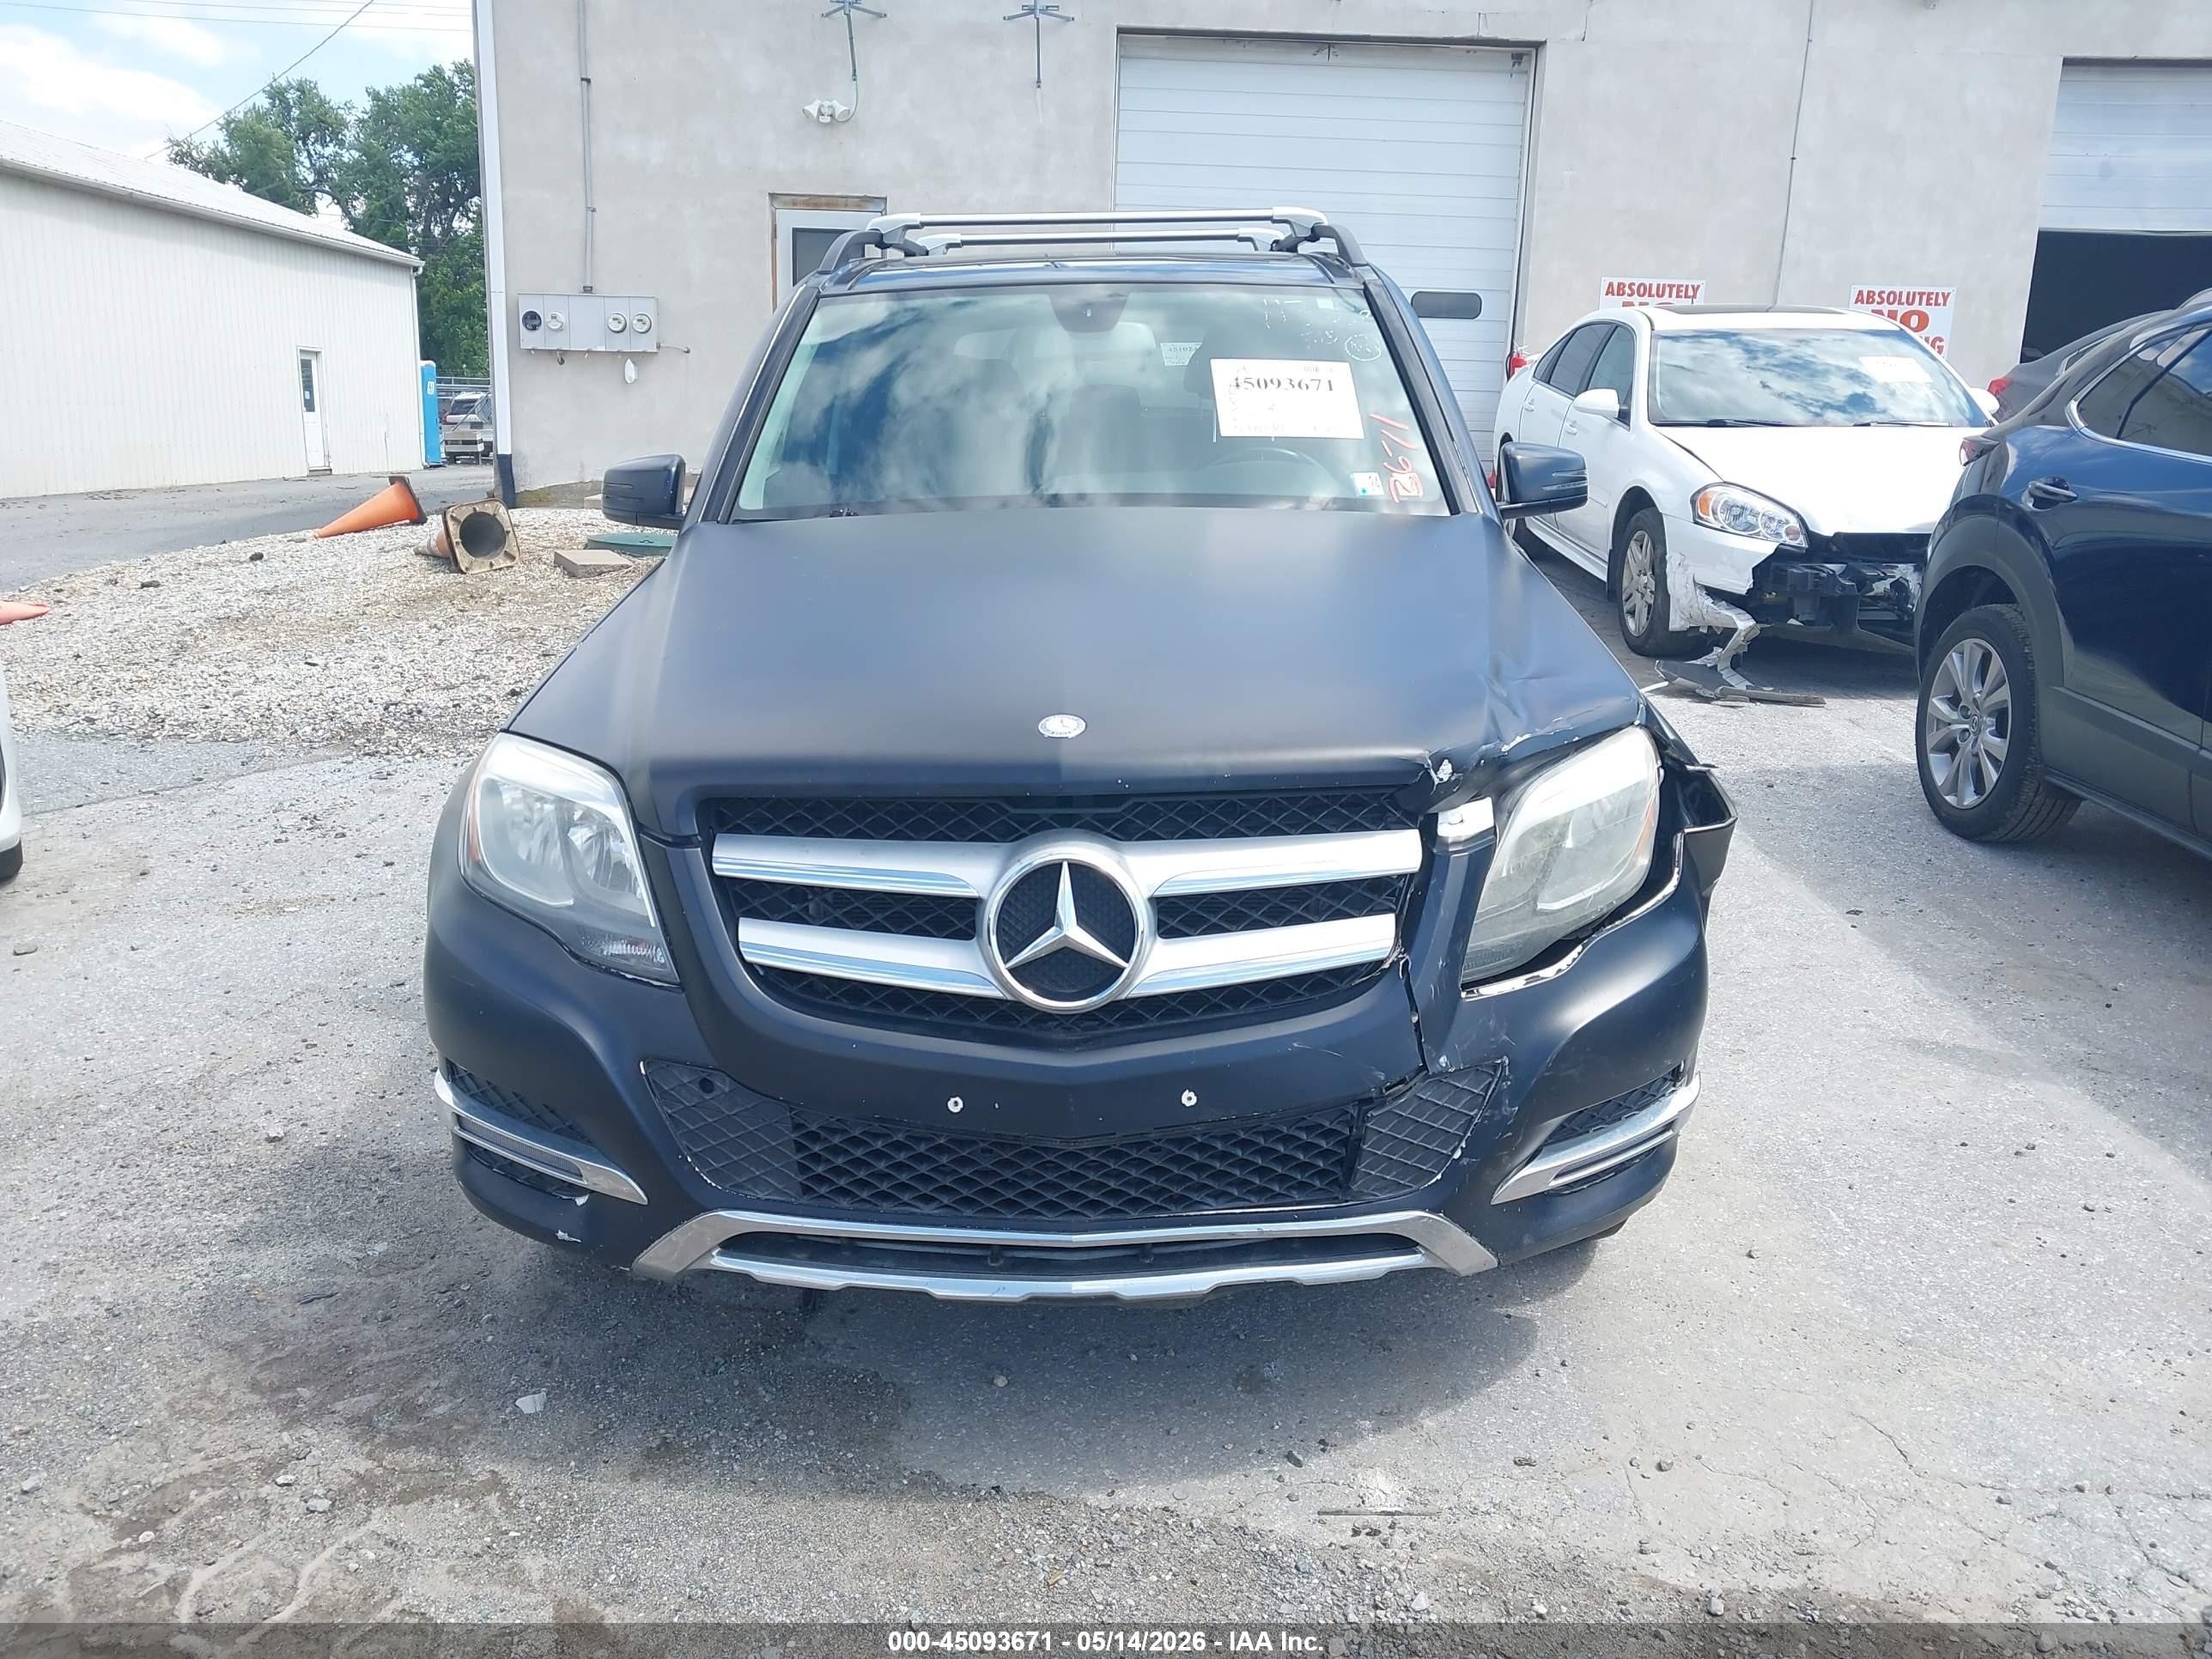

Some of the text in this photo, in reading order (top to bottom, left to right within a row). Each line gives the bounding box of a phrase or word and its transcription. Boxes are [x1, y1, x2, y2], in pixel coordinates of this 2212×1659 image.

[1605, 281, 1701, 300] ABSOLUTELY
[1854, 289, 1952, 307] ABSOLUTELY
[1230, 375, 1334, 392] 45093671
